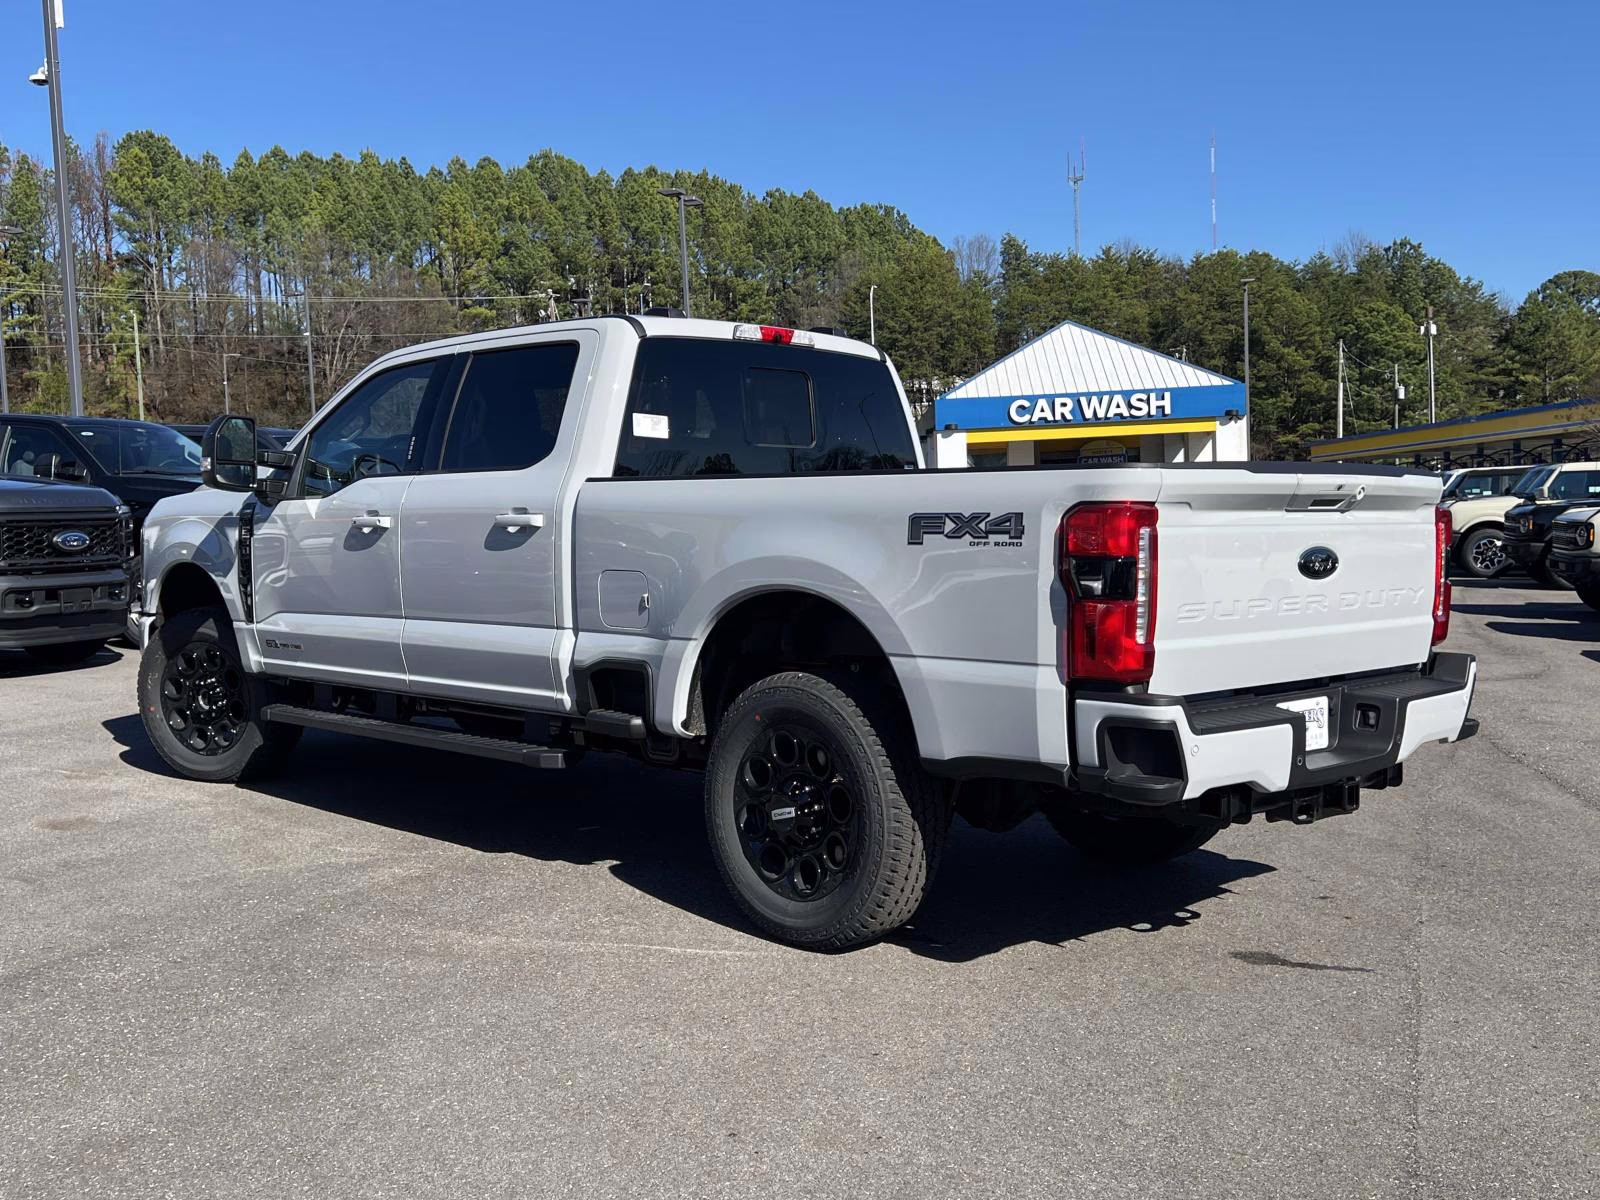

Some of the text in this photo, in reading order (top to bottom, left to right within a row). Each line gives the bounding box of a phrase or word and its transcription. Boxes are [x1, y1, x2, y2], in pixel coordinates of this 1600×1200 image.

[1009, 391, 1172, 424] CAR WASH
[1100, 455, 1125, 464] WASH
[907, 512, 1025, 545] FX4
[1177, 587, 1425, 624] SUPER DUTY
